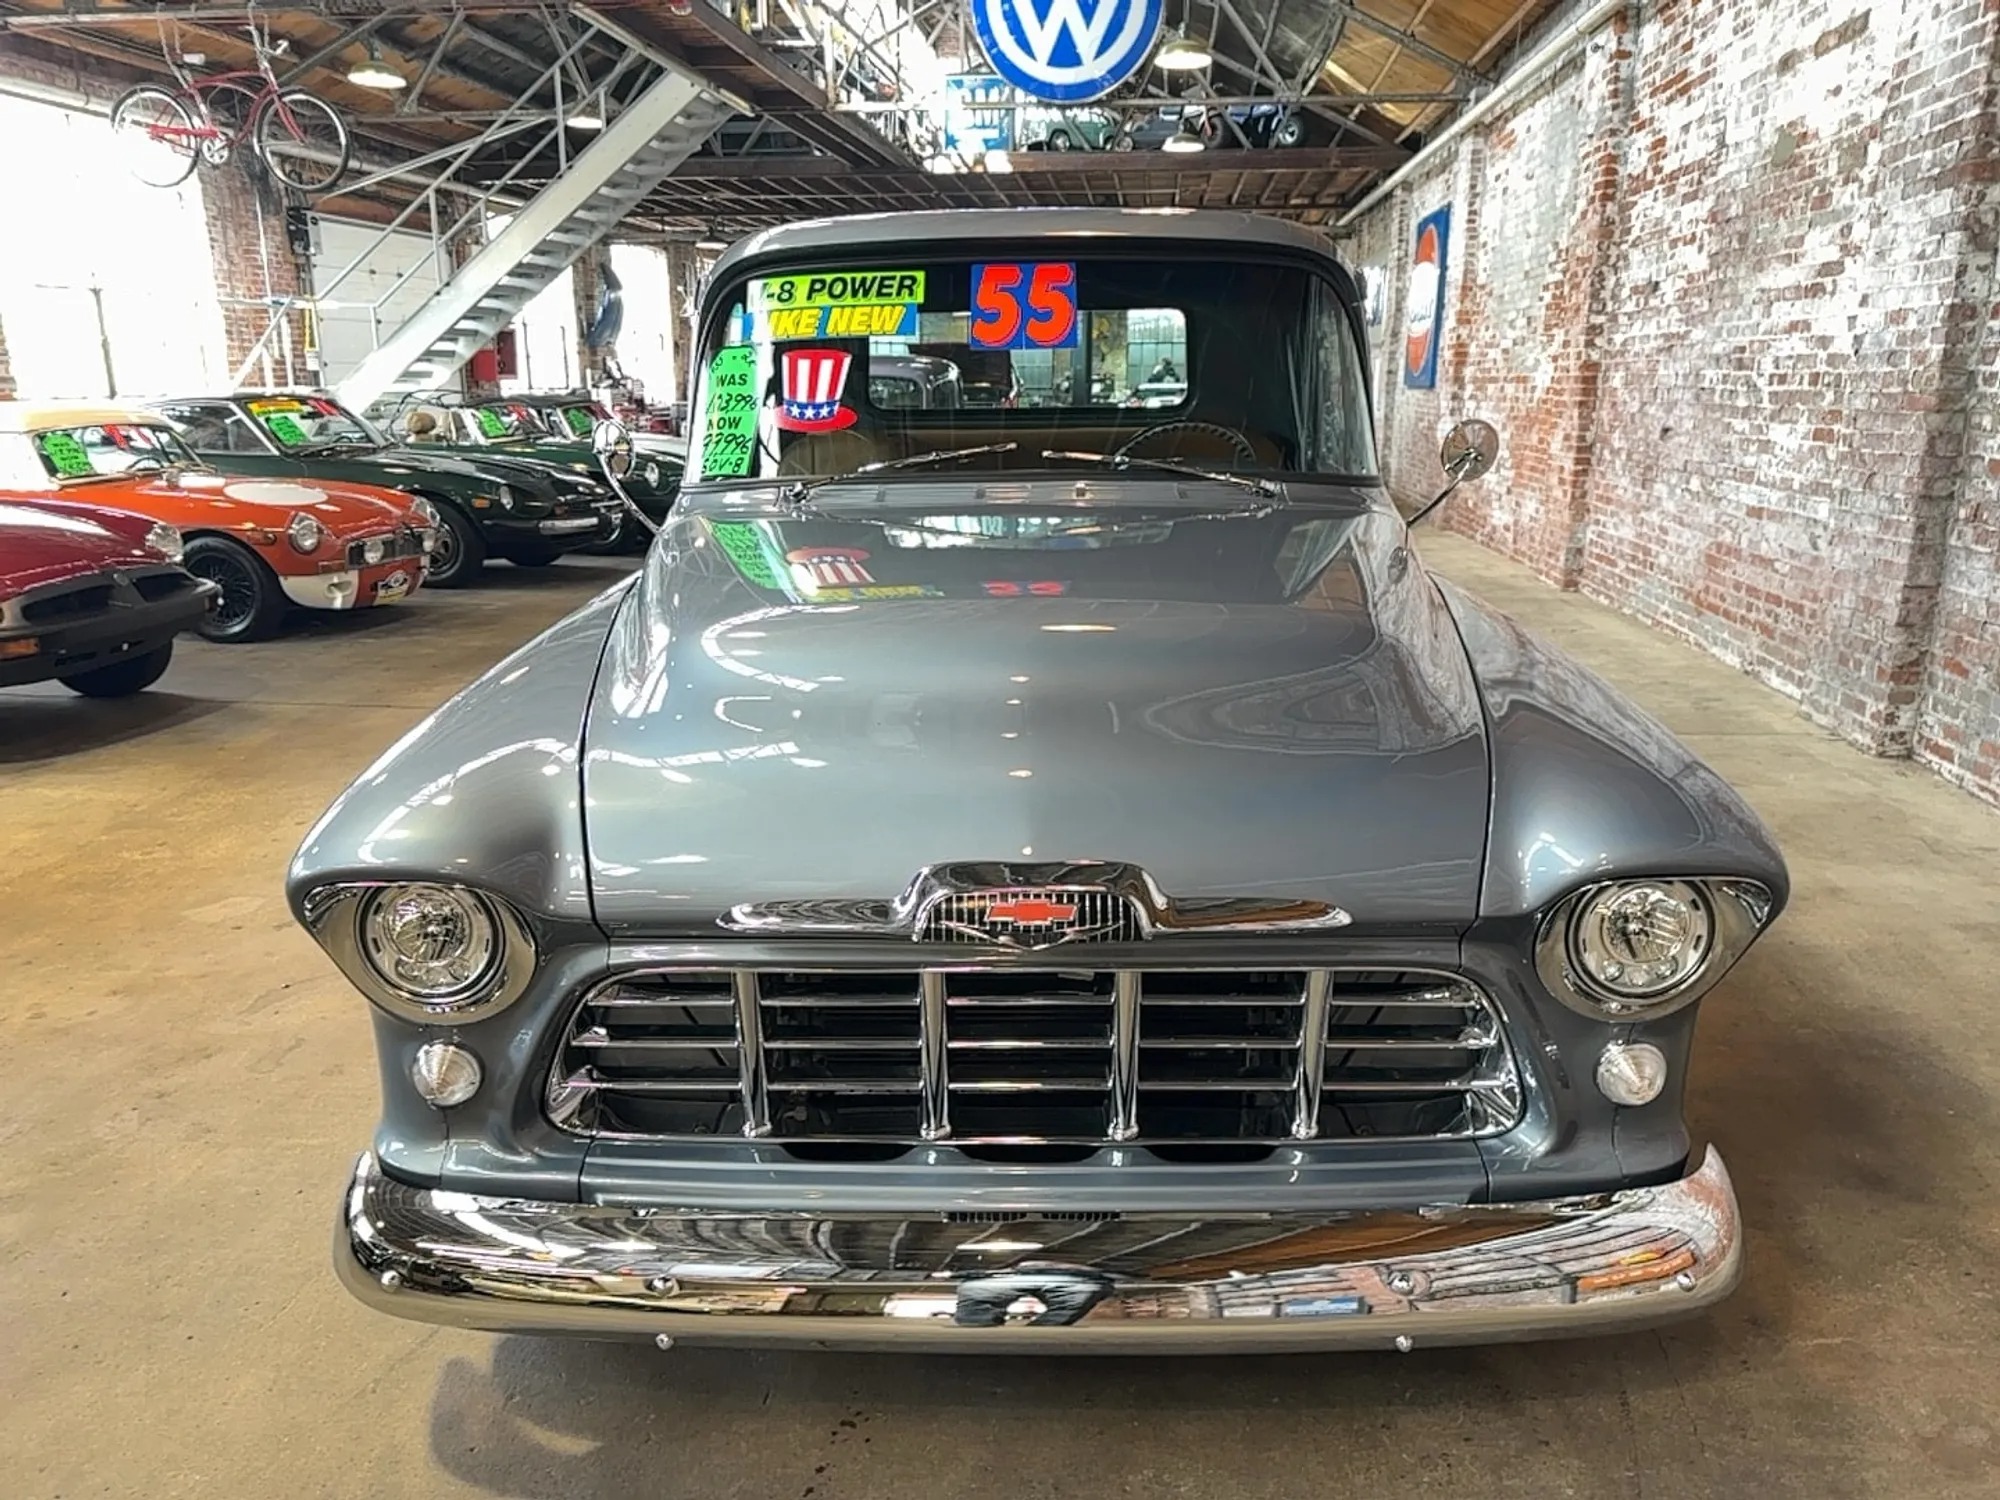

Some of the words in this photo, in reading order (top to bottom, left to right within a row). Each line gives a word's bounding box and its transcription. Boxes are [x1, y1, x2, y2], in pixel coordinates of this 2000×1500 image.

[806, 275, 918, 301] POWER
[972, 264, 1075, 347] 55
[769, 308, 823, 337] IKE
[825, 305, 907, 335] NEW
[716, 373, 748, 387] WAS
